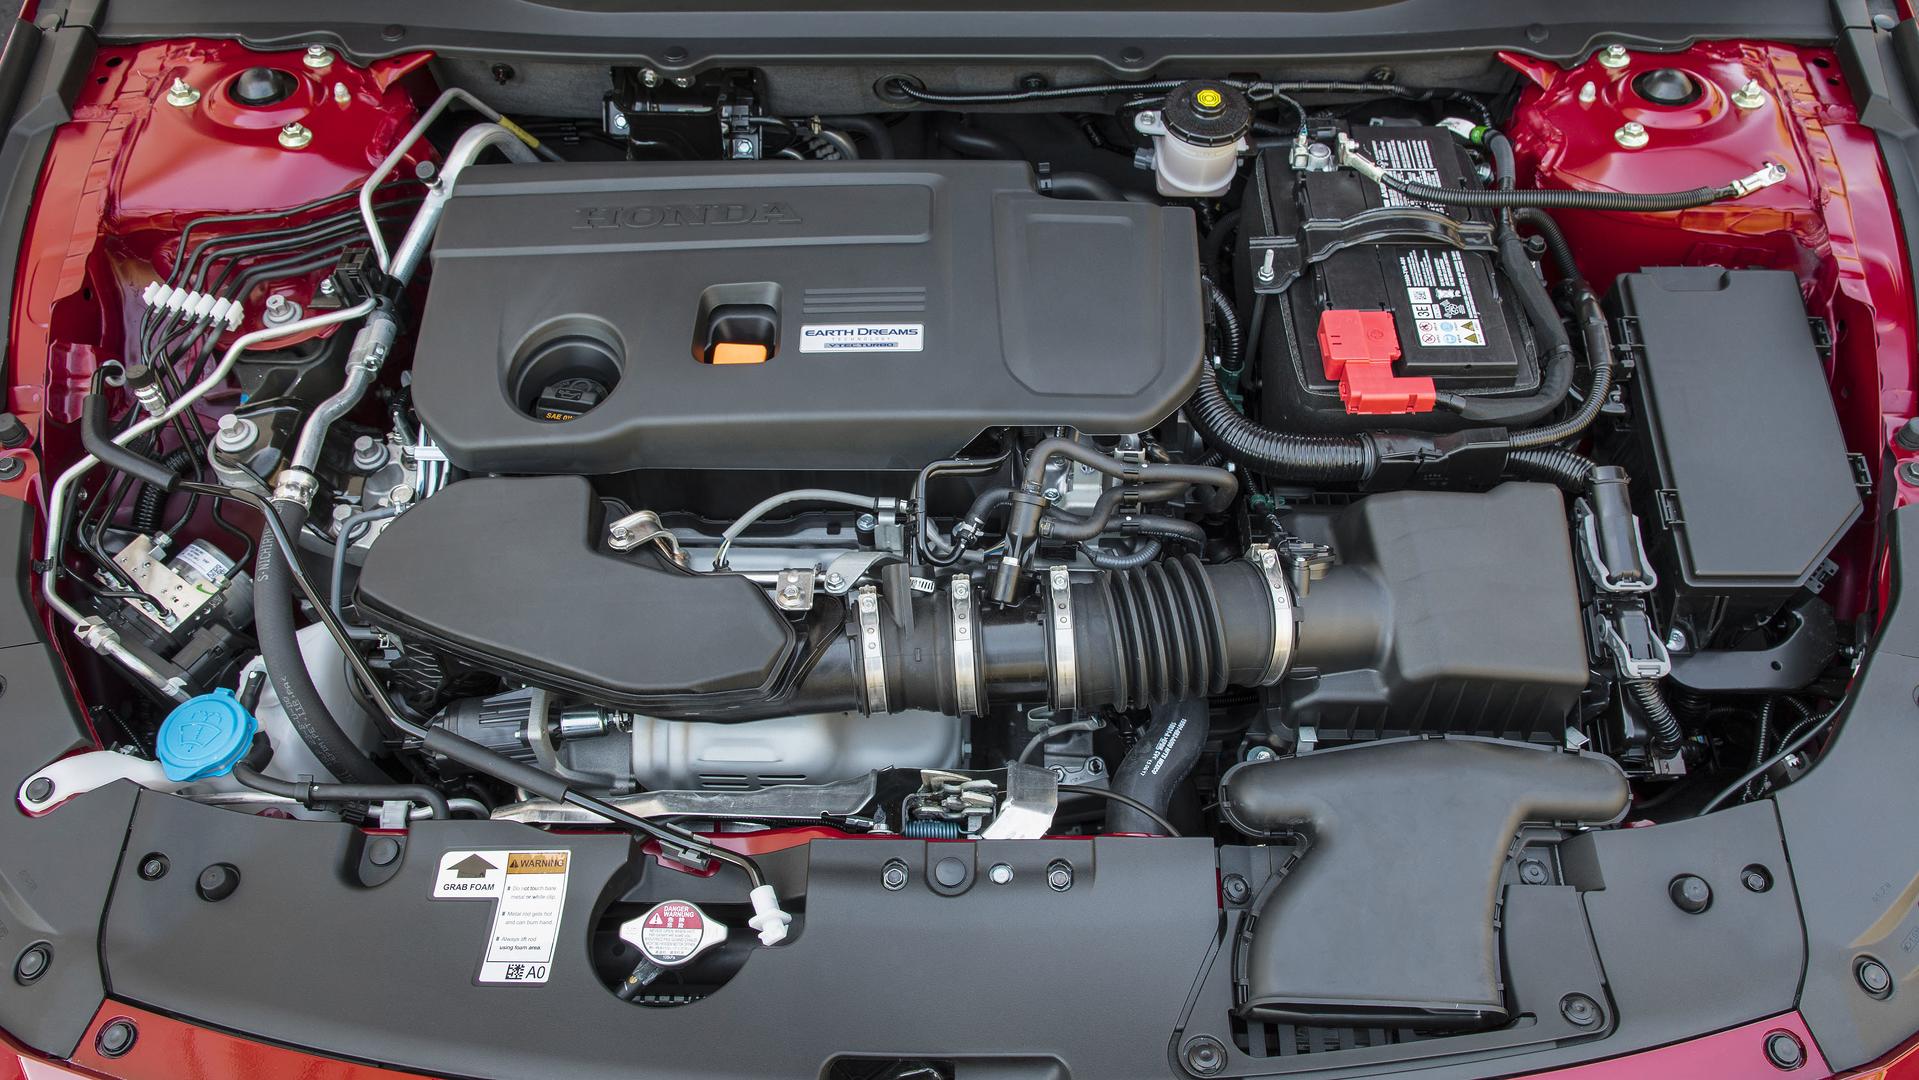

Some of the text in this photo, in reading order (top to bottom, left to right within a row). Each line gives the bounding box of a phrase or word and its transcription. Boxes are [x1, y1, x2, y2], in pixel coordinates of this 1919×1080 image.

[572, 203, 802, 229] HONDA
[857, 328, 918, 336] DREAMS
[545, 412, 561, 420] SAE
[520, 859, 564, 867] WARNING
[443, 883, 495, 891] GRAB FOAM
[525, 965, 546, 979] A0
